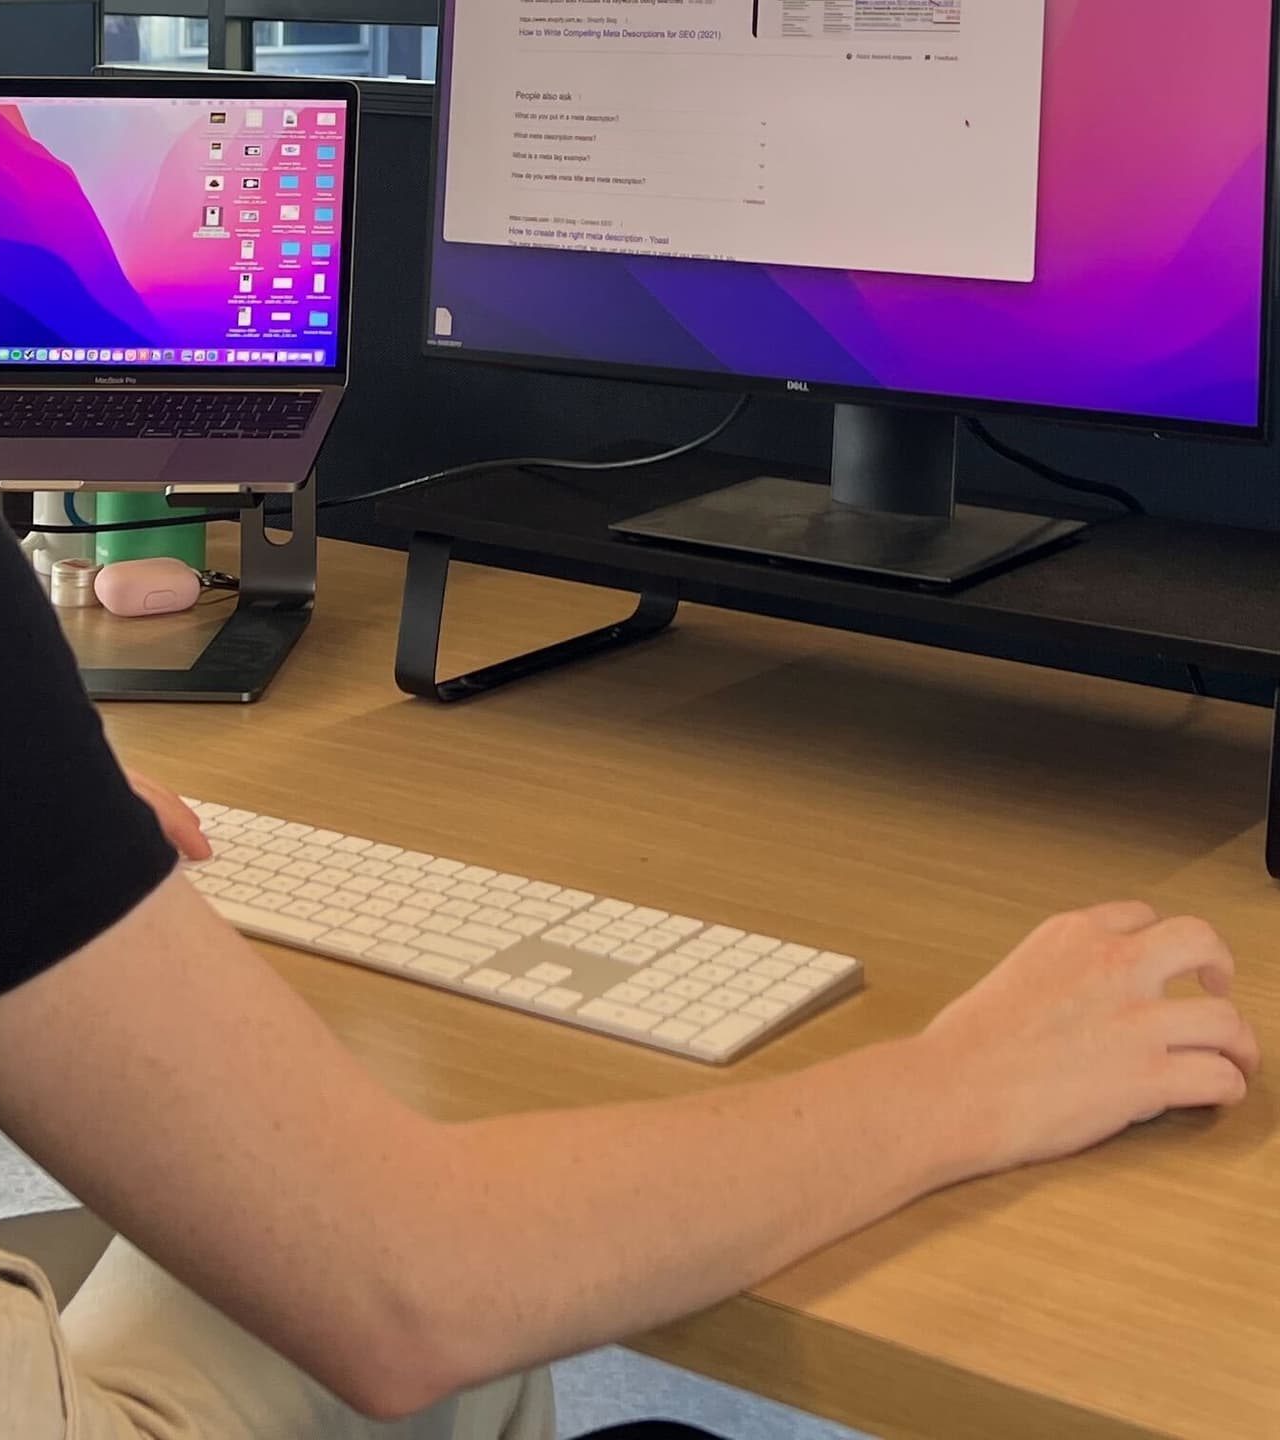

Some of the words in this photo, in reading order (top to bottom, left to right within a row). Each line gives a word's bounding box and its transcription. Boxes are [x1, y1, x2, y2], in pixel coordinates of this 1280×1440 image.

[519, 29, 534, 37] How
[535, 29, 543, 37] to
[543, 29, 562, 37] Write
[563, 28, 601, 40] Compelling
[603, 29, 620, 38] Meta
[622, 29, 666, 41] Descriptions
[667, 30, 677, 39] for
[678, 29, 696, 39] SEO
[697, 30, 721, 40] (2021)
[515, 91, 541, 102] People
[542, 91, 558, 101] also
[559, 91, 572, 101] ask
[514, 111, 529, 119] What
[585, 114, 620, 123] description?
[508, 226, 524, 235] How
[525, 227, 532, 236] to
[533, 228, 555, 237] create
[556, 229, 568, 238] the
[569, 229, 585, 241] right
[585, 231, 603, 240] meta
[605, 232, 643, 245] description
[649, 235, 670, 245] Yoast
[125, 376, 137, 385] Pro
[787, 380, 810, 392] DELL
